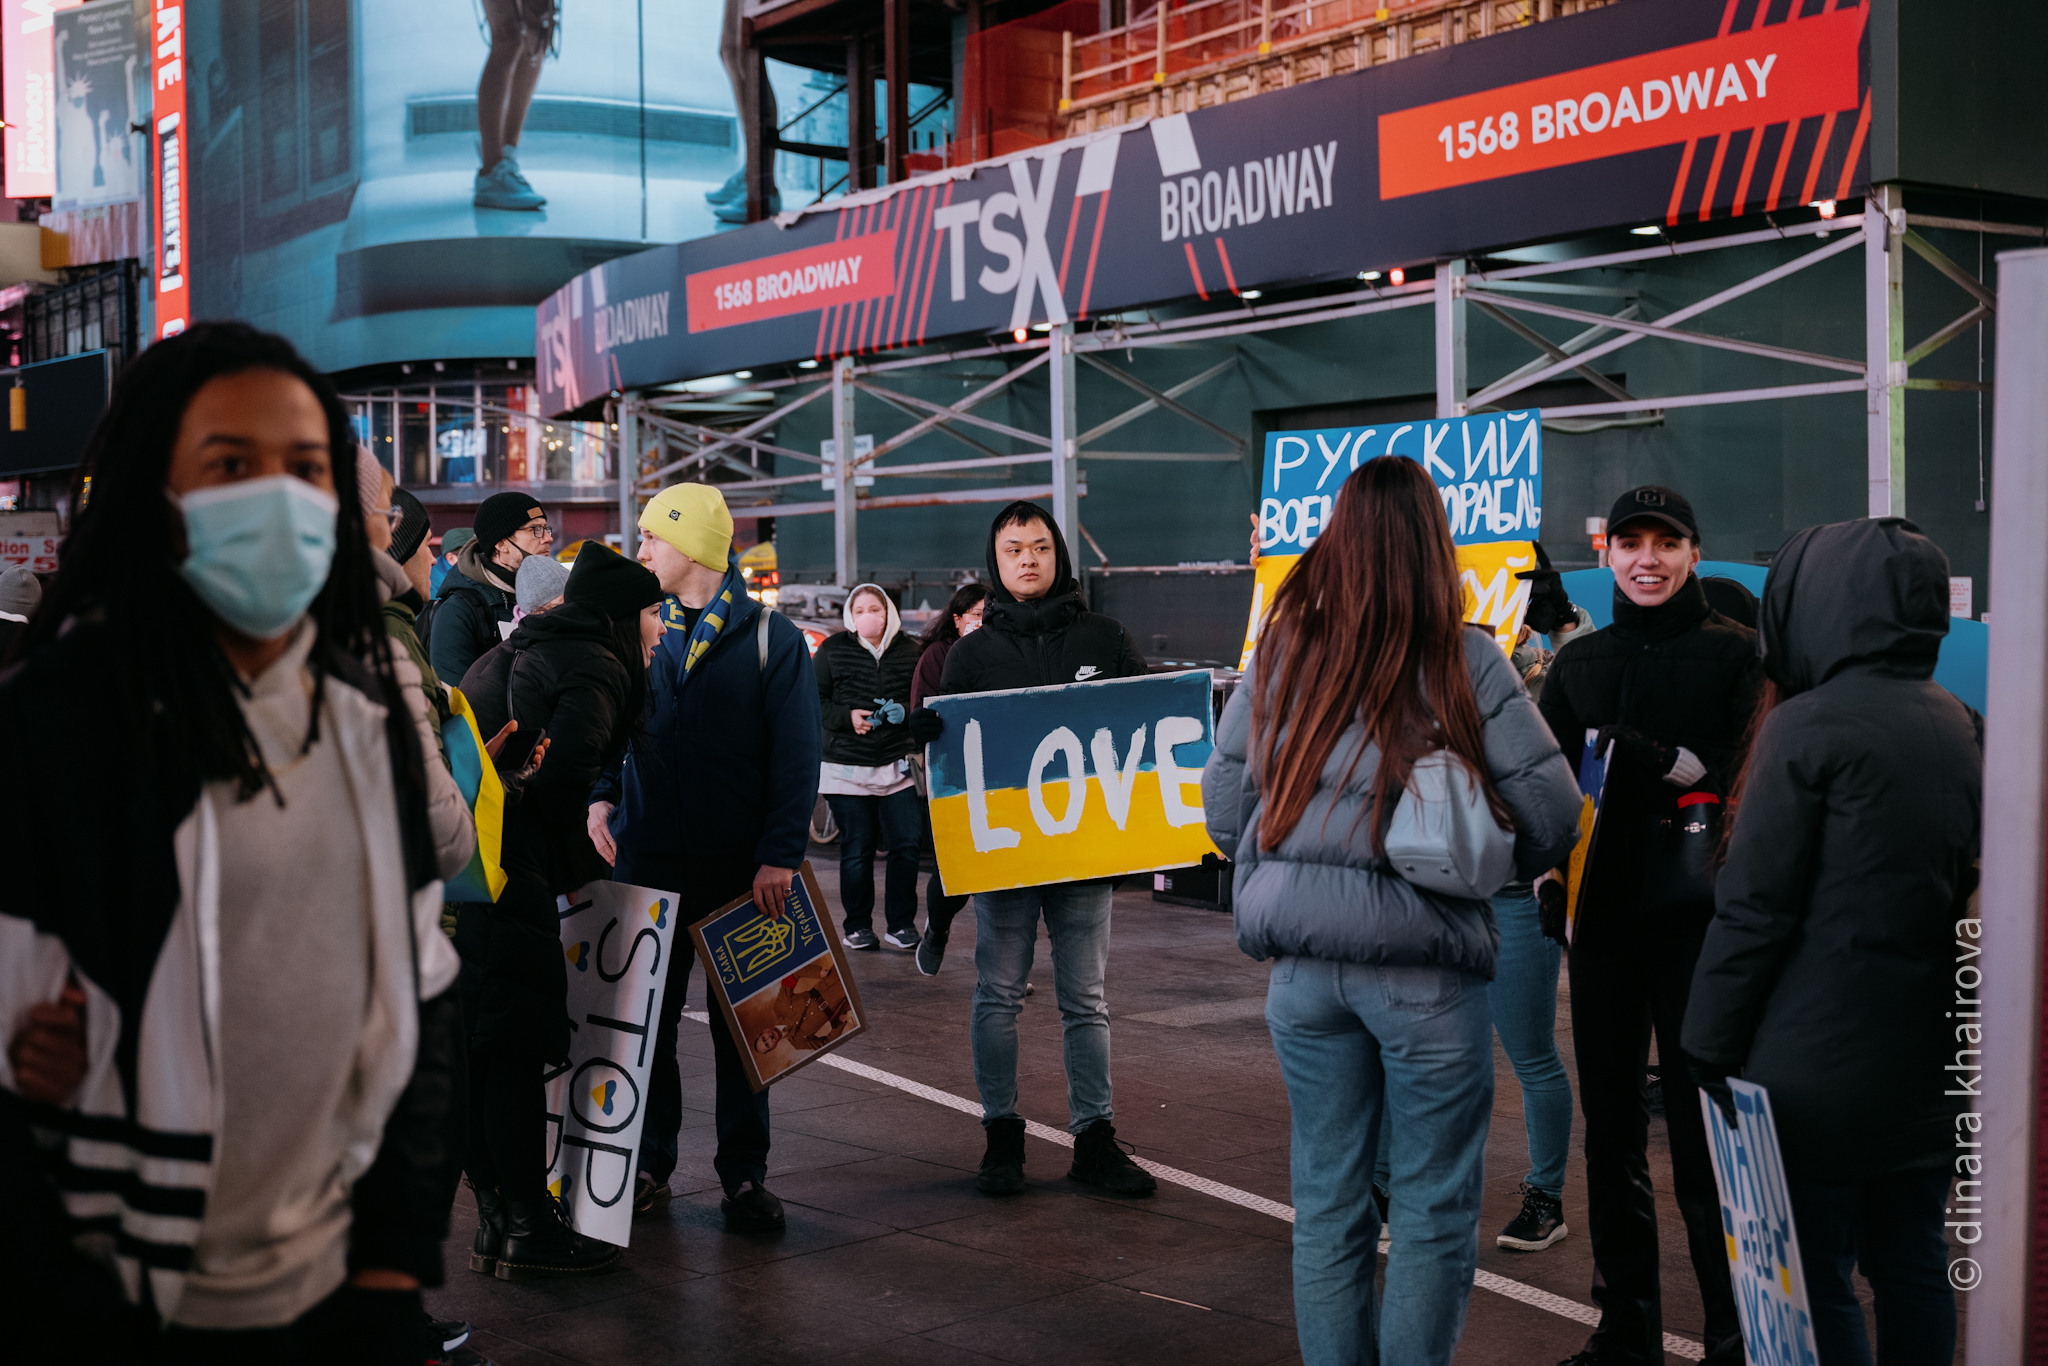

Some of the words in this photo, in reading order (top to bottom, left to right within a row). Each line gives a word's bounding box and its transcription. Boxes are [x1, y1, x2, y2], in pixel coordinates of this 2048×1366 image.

[1438, 111, 1519, 163] 1568
[1531, 53, 1777, 145] BROADWAY
[163, 134, 182, 269] HERSHEY'S
[934, 153, 1069, 331] TSX
[1160, 140, 1338, 243] BROADWAY
[714, 279, 752, 311] 1568
[756, 255, 863, 304] BROADWAY
[1438, 477, 1542, 538] ОРАБЛЬ
[1079, 665, 1097, 675] NIKE
[963, 715, 1207, 854] LOVE
[562, 916, 662, 1208] STOP
[1707, 1089, 1789, 1243] NATO
[1739, 1217, 1775, 1283] HELP
